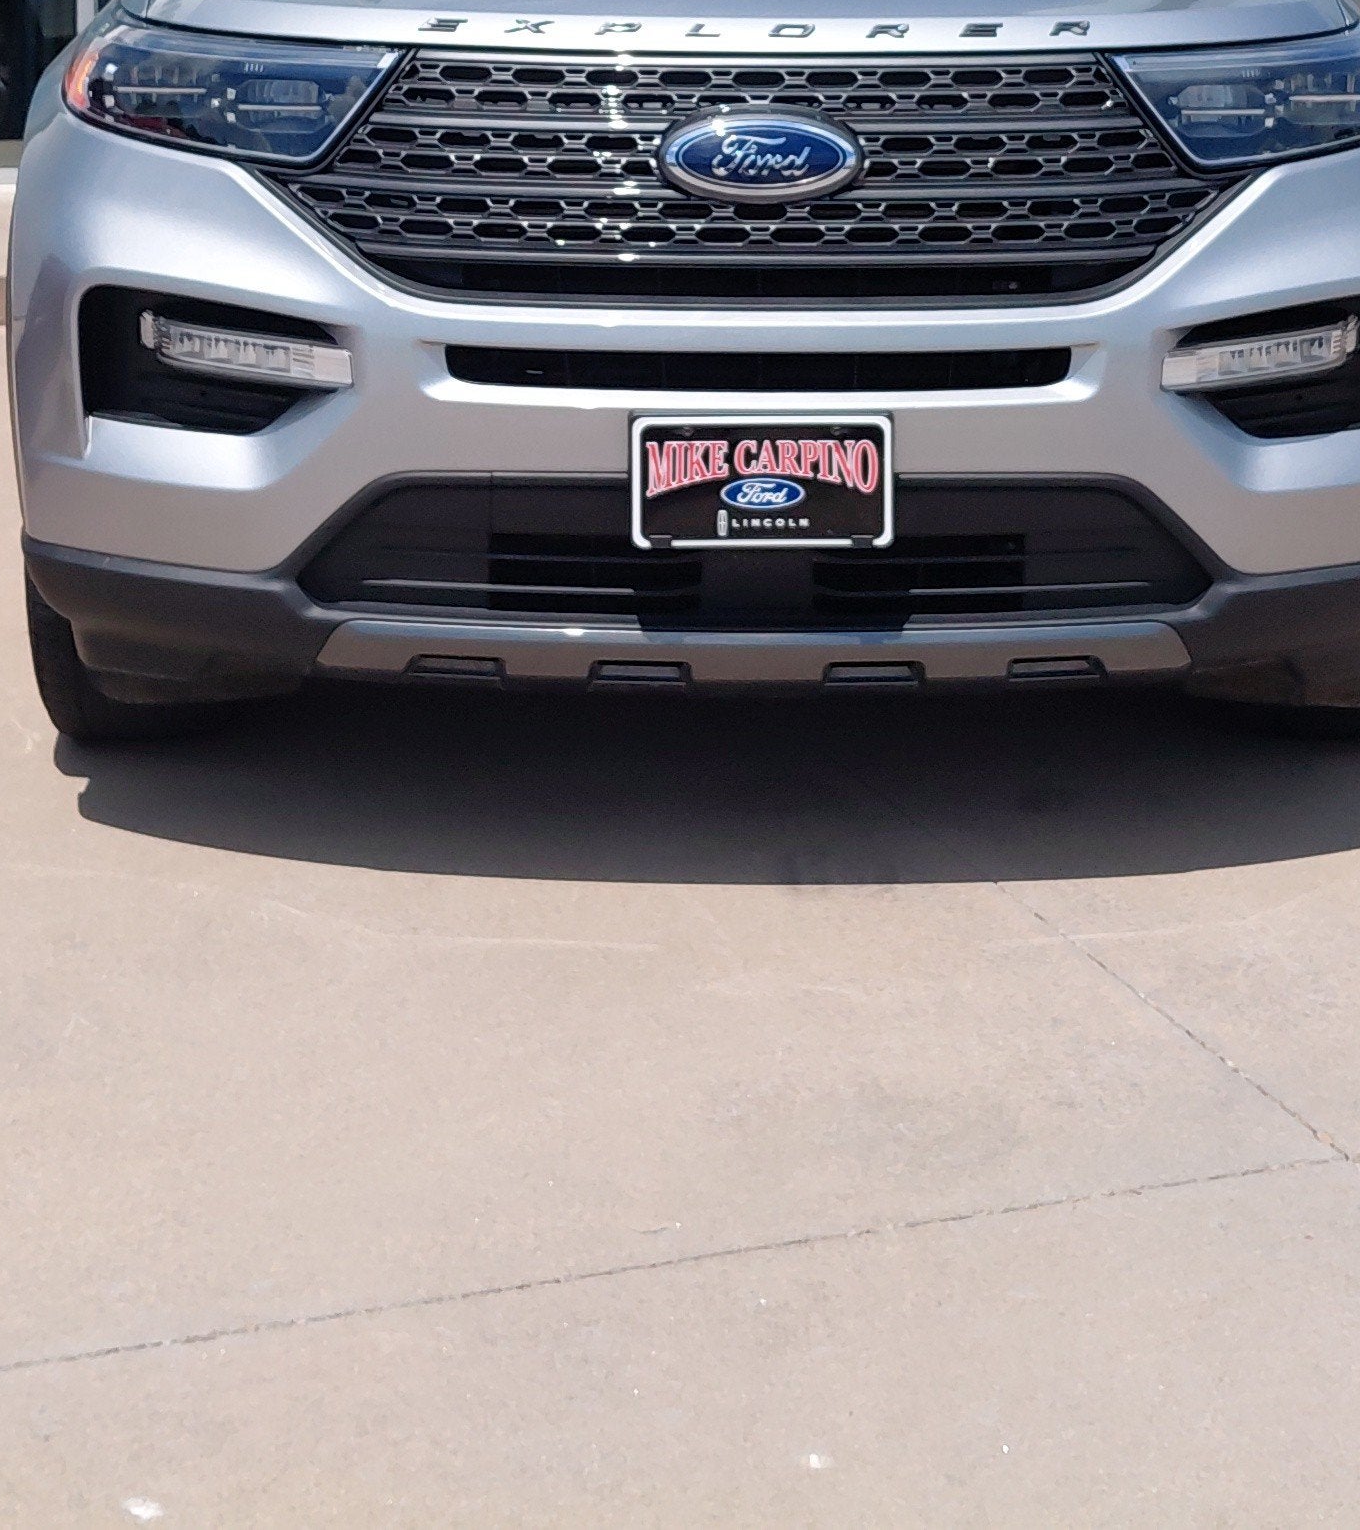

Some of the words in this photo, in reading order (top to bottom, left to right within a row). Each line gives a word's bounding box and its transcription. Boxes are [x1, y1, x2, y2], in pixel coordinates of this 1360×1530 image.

[417, 17, 1091, 38] EXPLORER
[711, 134, 812, 177] Ford
[645, 440, 730, 497] MIKE
[733, 439, 879, 494] CARPINO
[736, 483, 789, 504] Ford
[731, 517, 810, 528] LINCOLN
